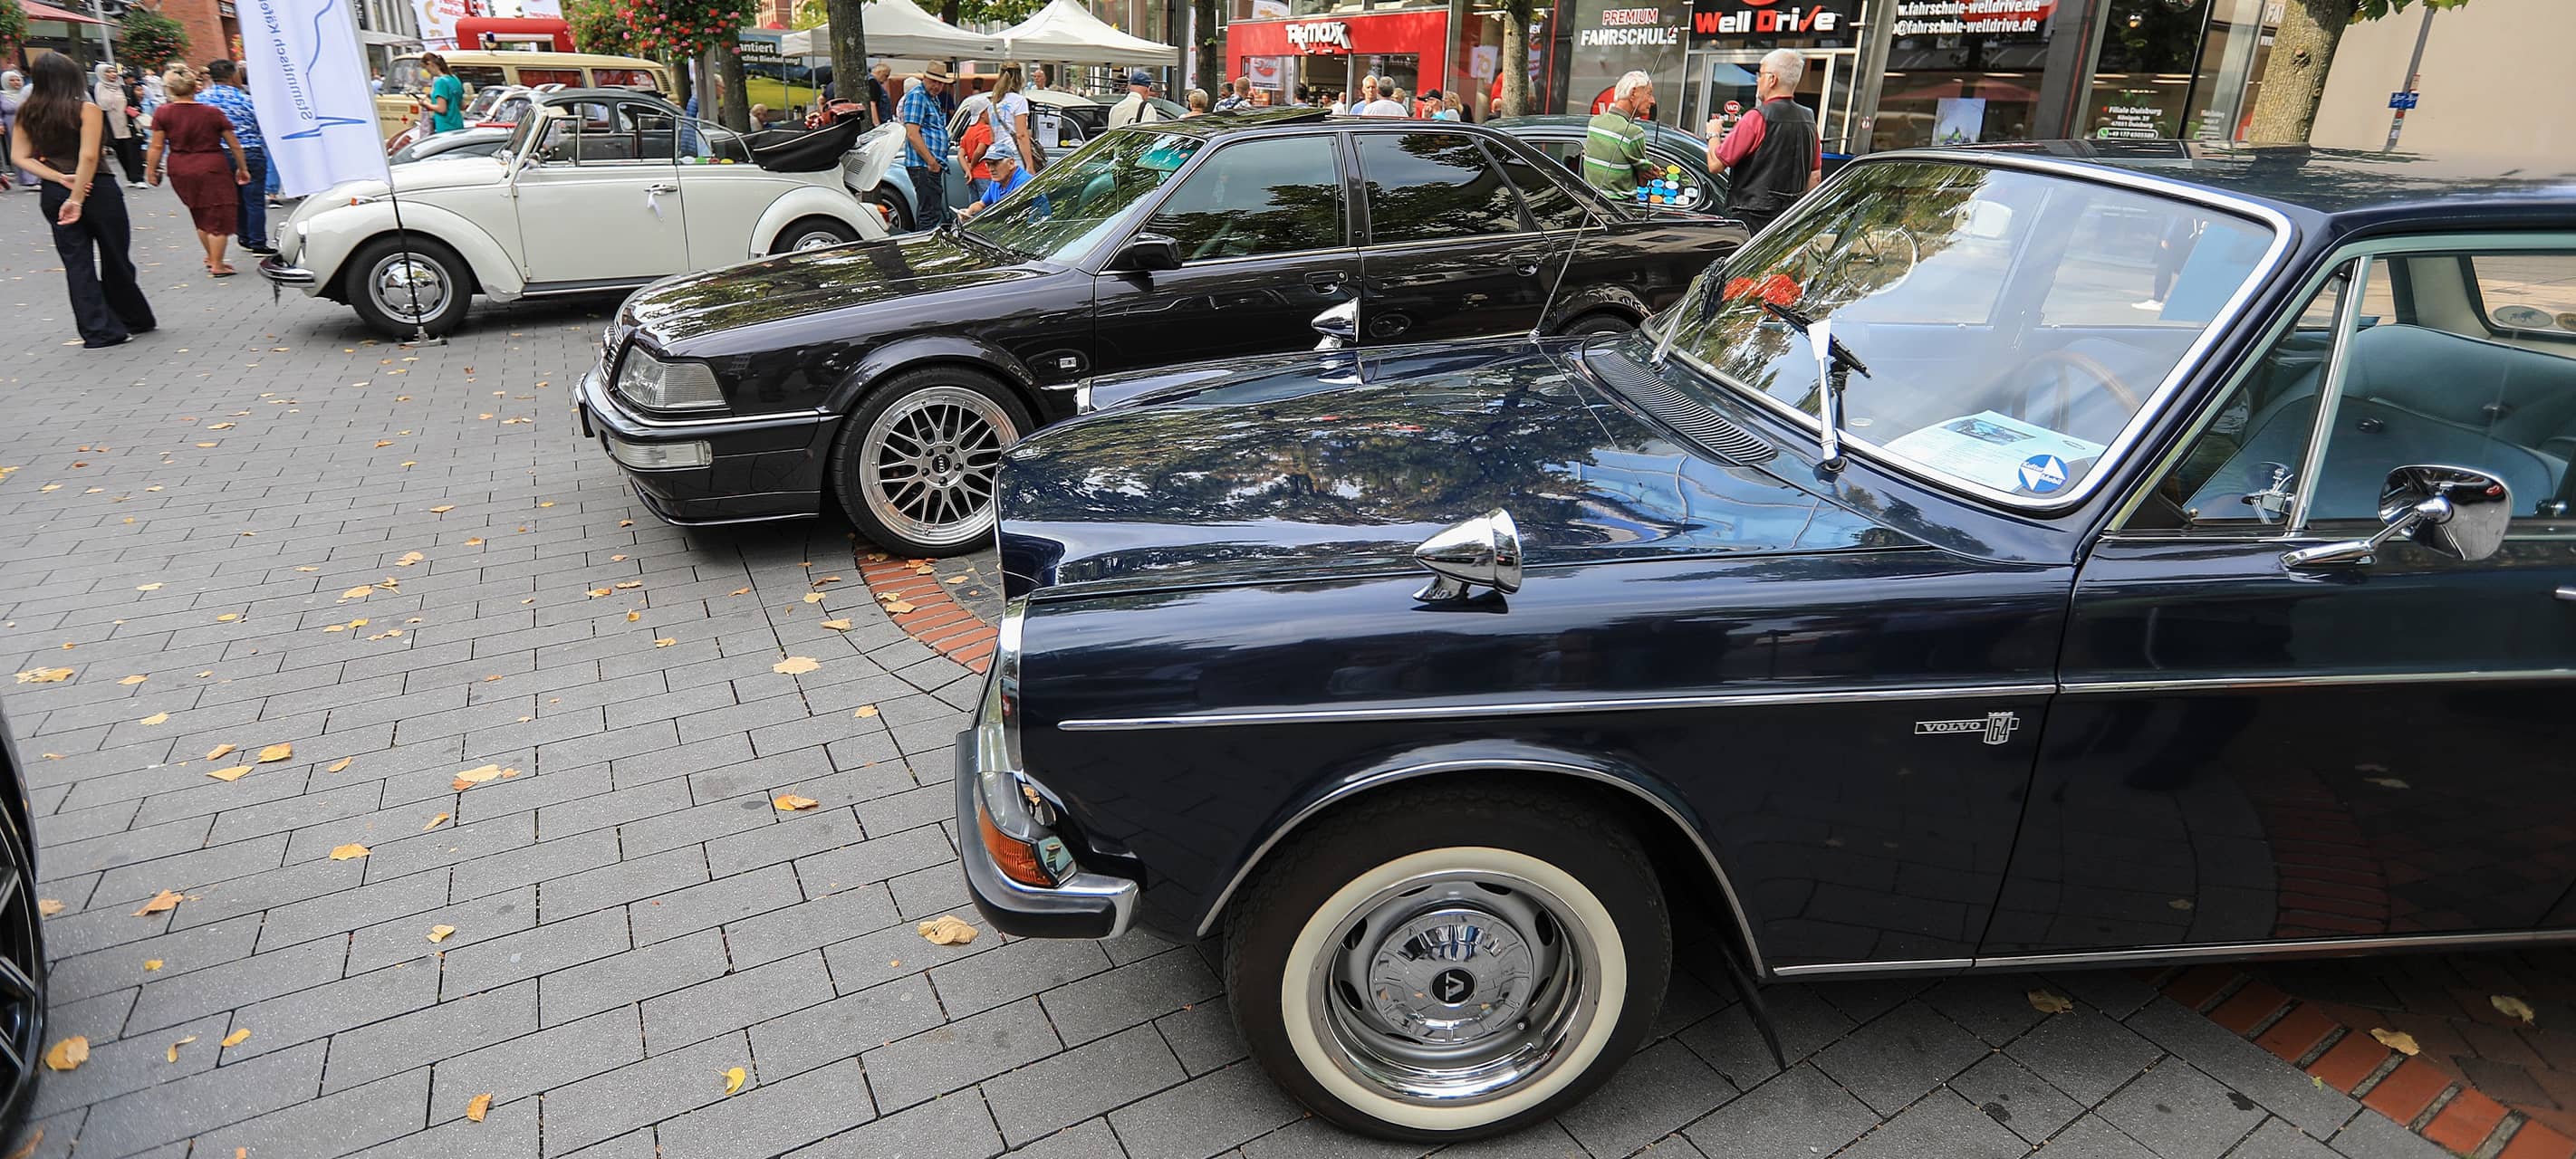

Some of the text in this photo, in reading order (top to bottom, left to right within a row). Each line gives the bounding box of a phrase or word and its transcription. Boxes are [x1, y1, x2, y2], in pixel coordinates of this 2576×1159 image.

[1601, 8, 1658, 25] PREMIUM
[1695, 5, 1836, 34] Well Drive
[1580, 27, 1678, 45] FAHRSCHULE
[2129, 107, 2163, 117] Duisburg
[1923, 722, 1981, 732] VOLVO
